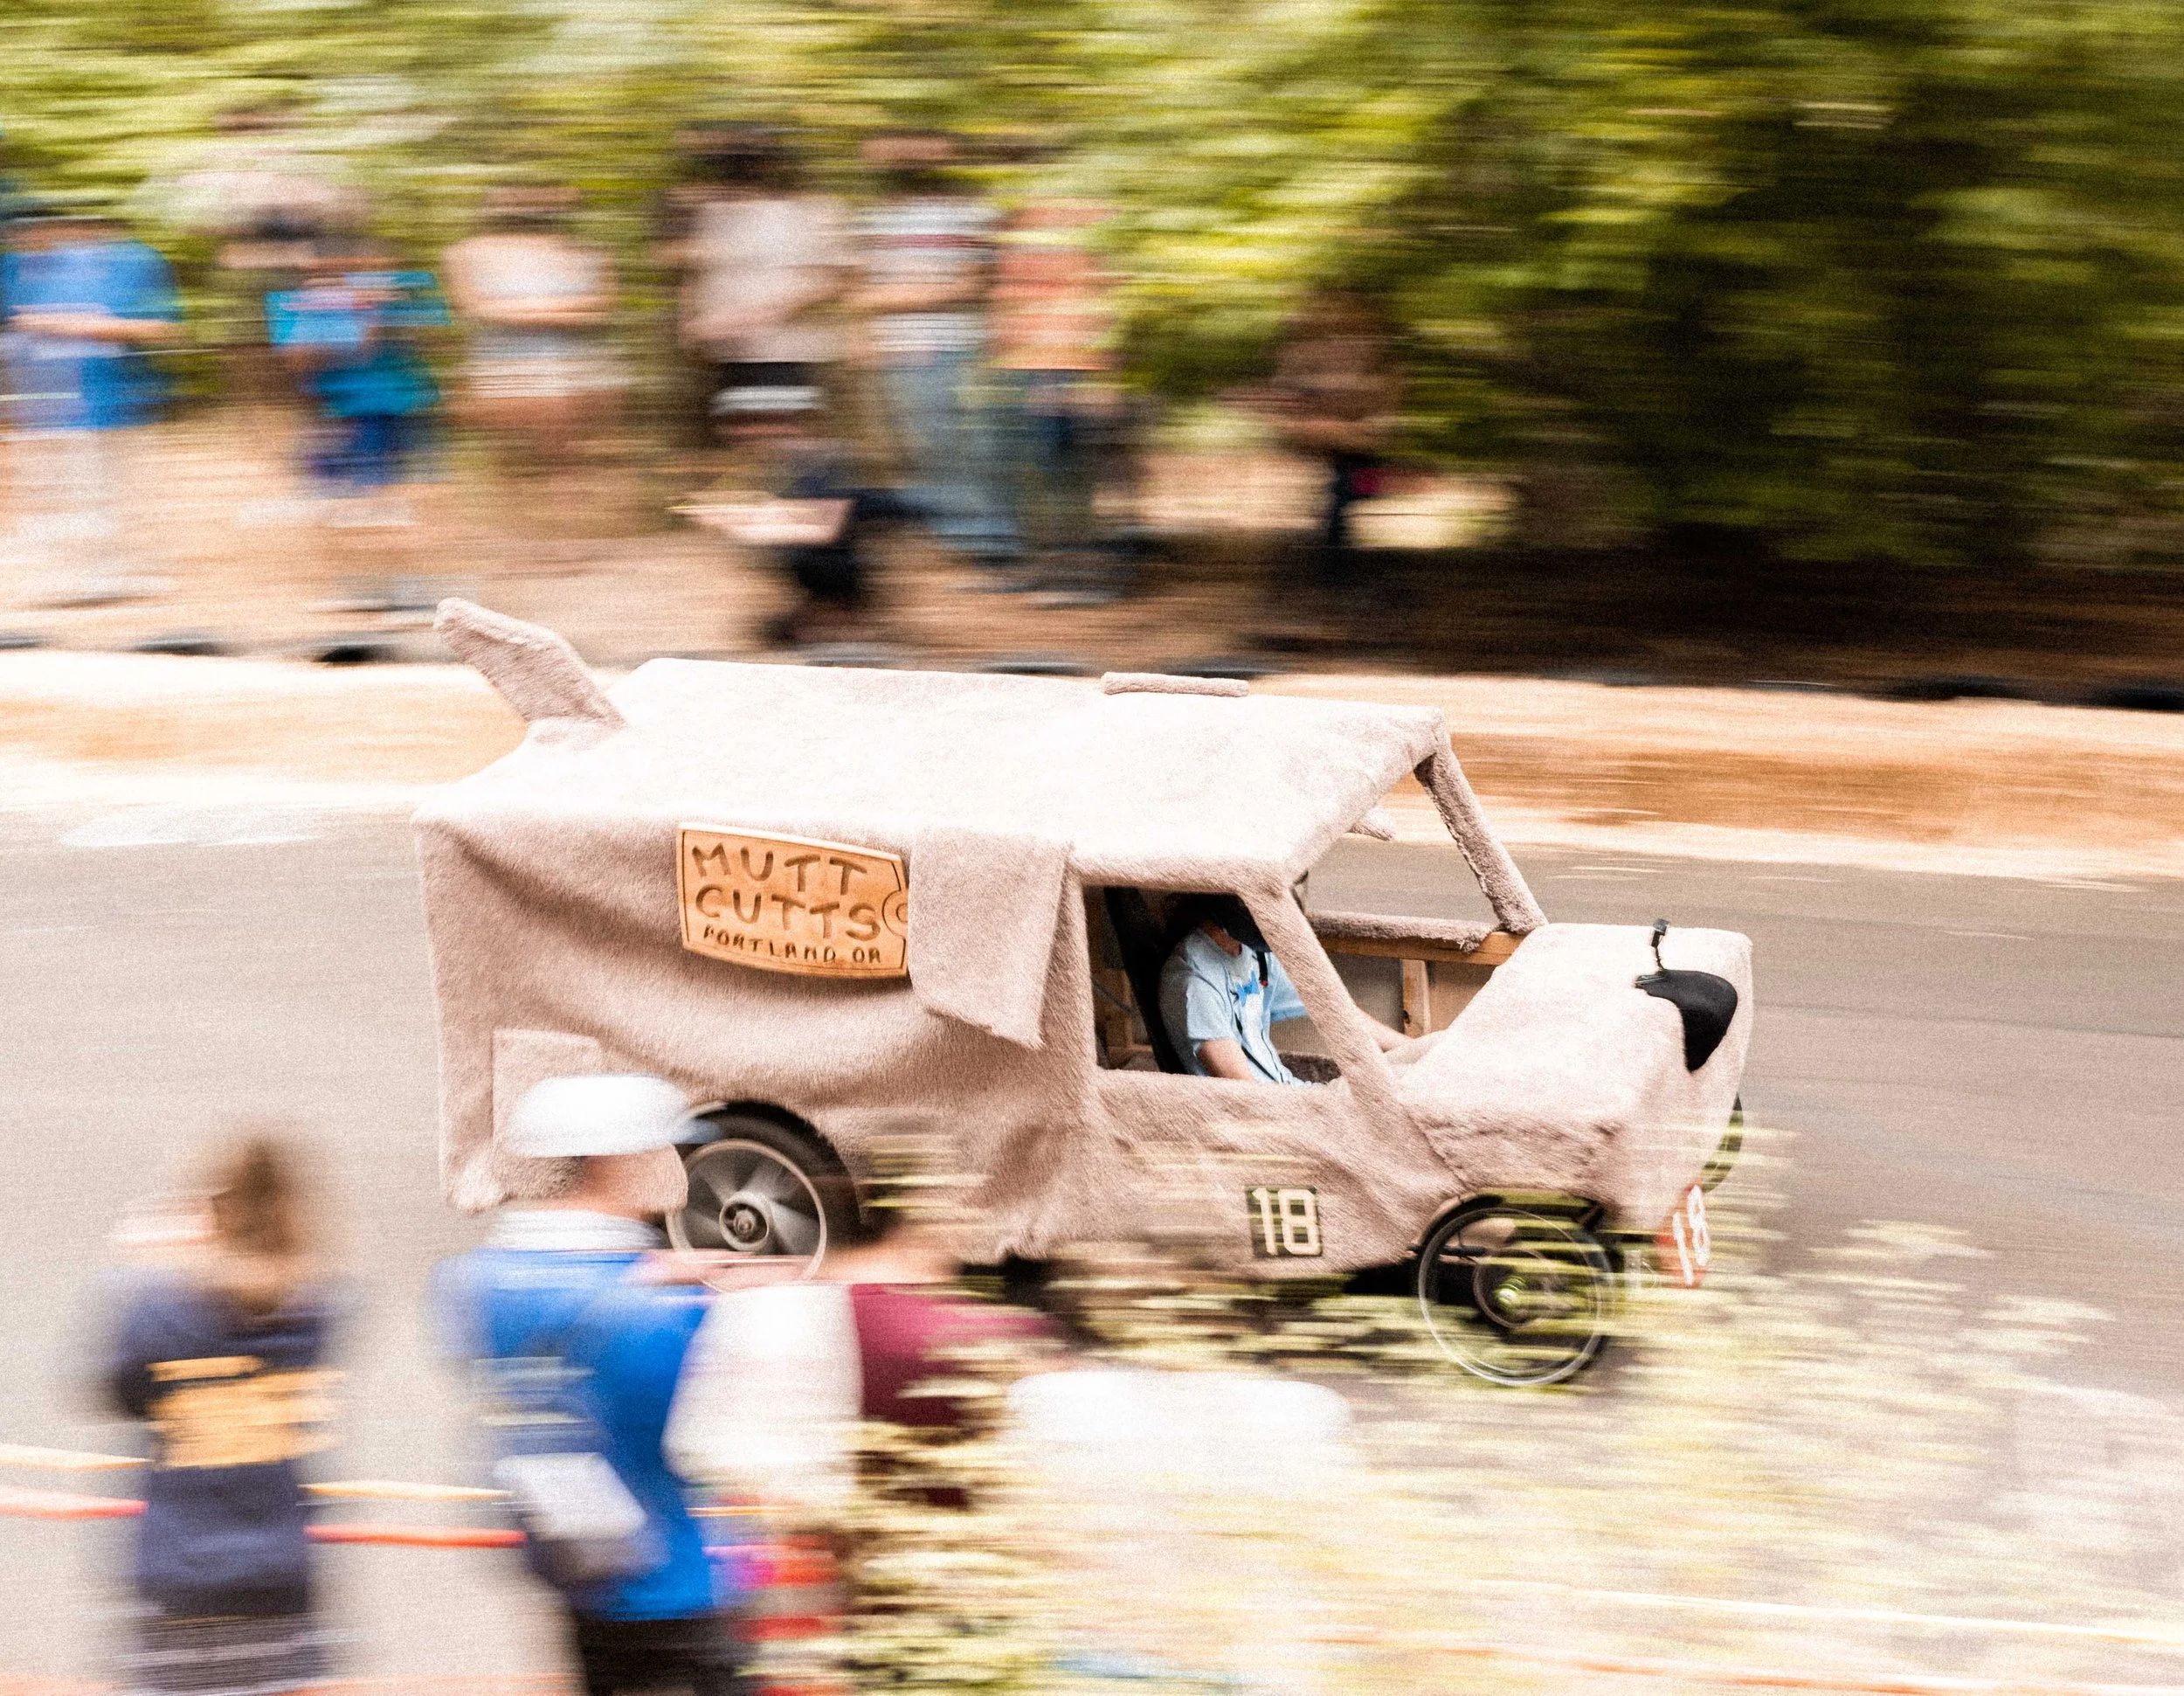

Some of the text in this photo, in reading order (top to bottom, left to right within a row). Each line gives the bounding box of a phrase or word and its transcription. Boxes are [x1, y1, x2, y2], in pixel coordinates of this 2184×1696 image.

[692, 842, 867, 896] MUTT
[695, 883, 881, 941] CUTTS
[703, 924, 881, 964] PORTLAND OR
[1251, 1187, 1321, 1256] 18
[1672, 1184, 1711, 1285] 18
